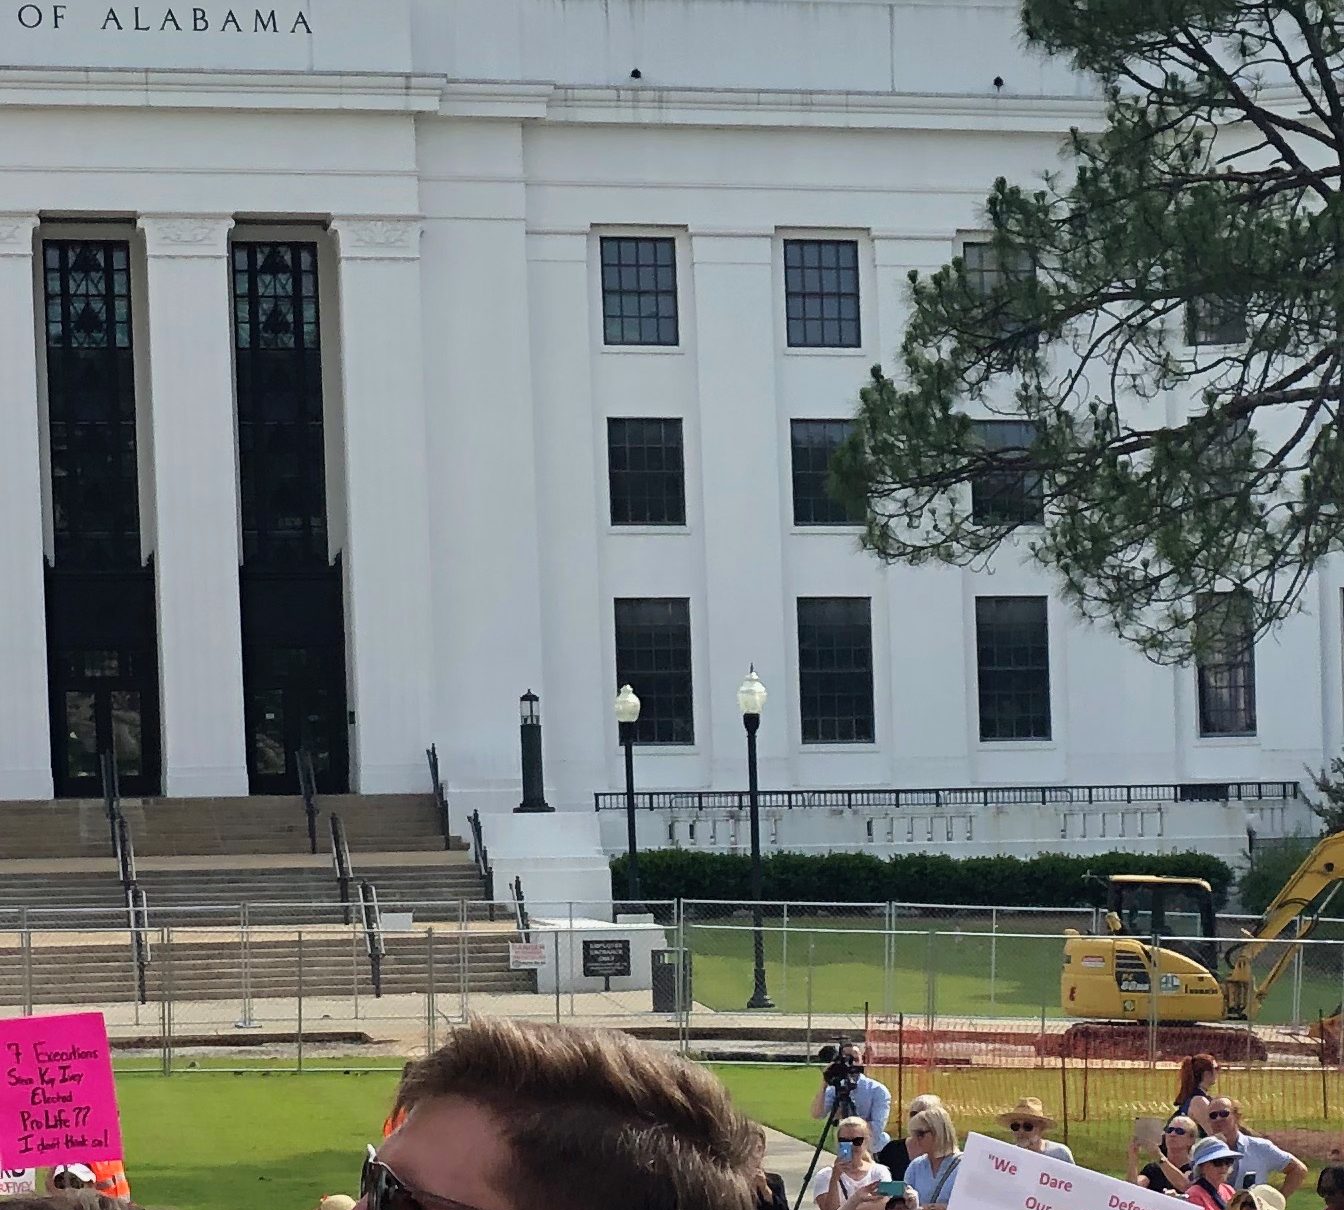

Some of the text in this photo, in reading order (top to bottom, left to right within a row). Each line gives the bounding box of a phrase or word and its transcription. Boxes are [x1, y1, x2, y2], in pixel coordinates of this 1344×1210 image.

[17, 3, 313, 34] OF ALABAMA
[7, 1041, 99, 1064] 7 Executions
[30, 1087, 73, 1106] Elected
[17, 1134, 34, 1154] I
[1039, 1171, 1073, 1192] Dare
